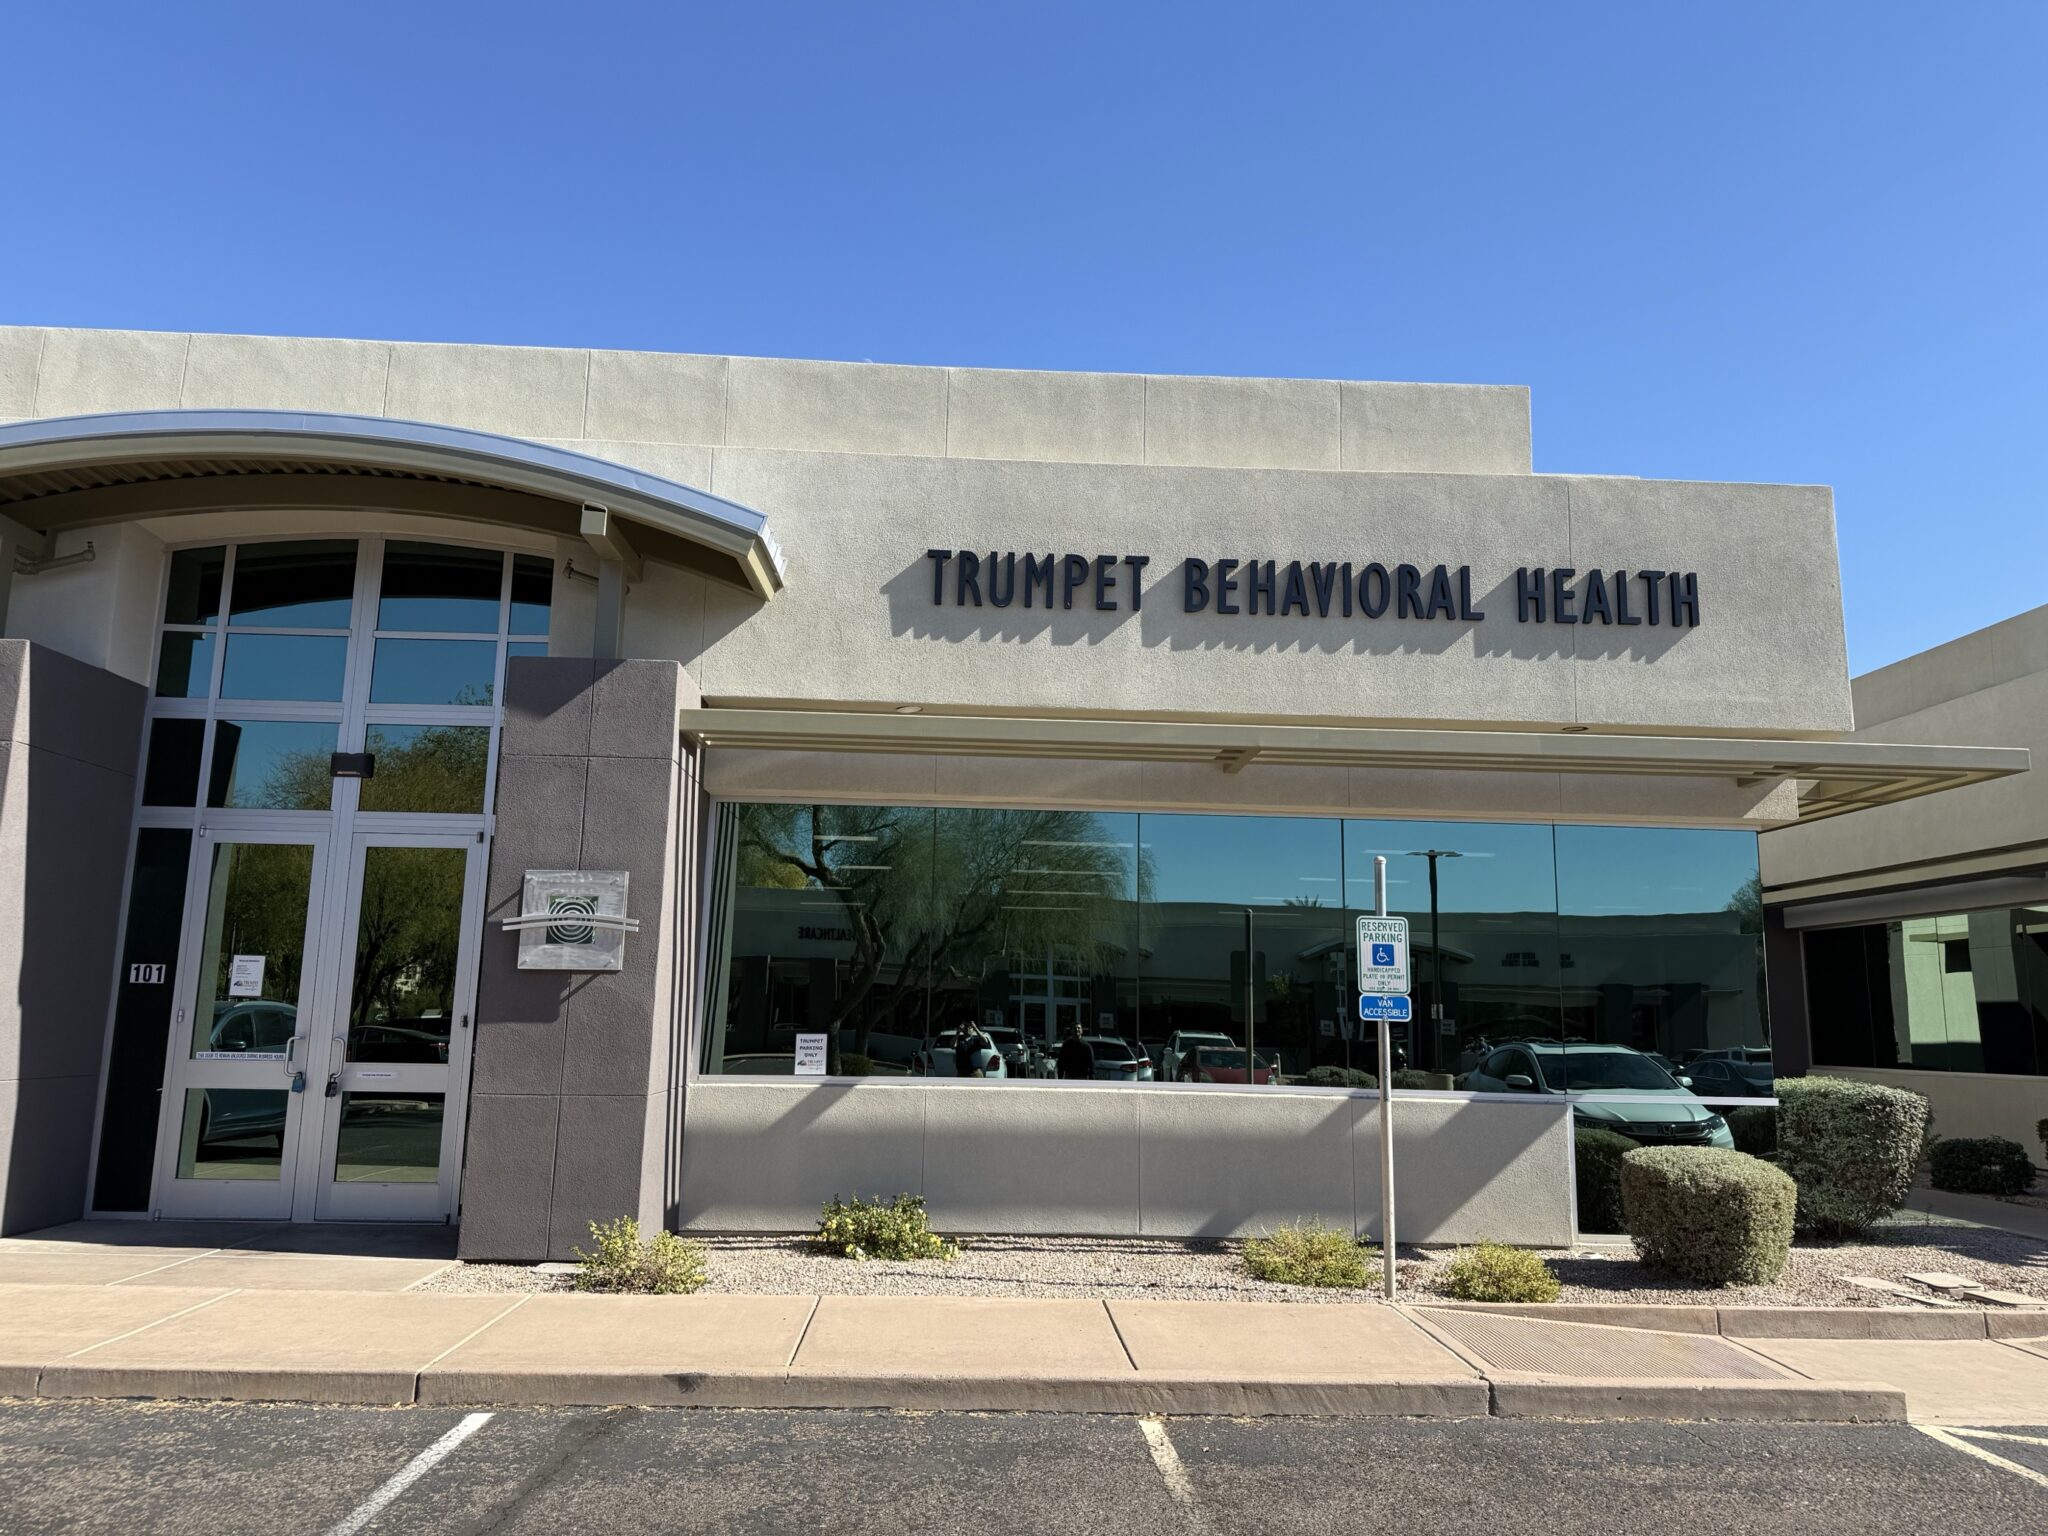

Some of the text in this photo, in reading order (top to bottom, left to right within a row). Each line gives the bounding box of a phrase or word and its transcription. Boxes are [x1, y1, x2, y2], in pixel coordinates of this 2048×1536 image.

[927, 549, 1700, 627] TRUMPET BEHAVIORAL HEALTH
[1361, 922, 1403, 932] RESERVED
[1363, 933, 1402, 943] PARKING
[133, 965, 163, 982] 101
[1364, 1008, 1408, 1017] ACCESSIBLE
